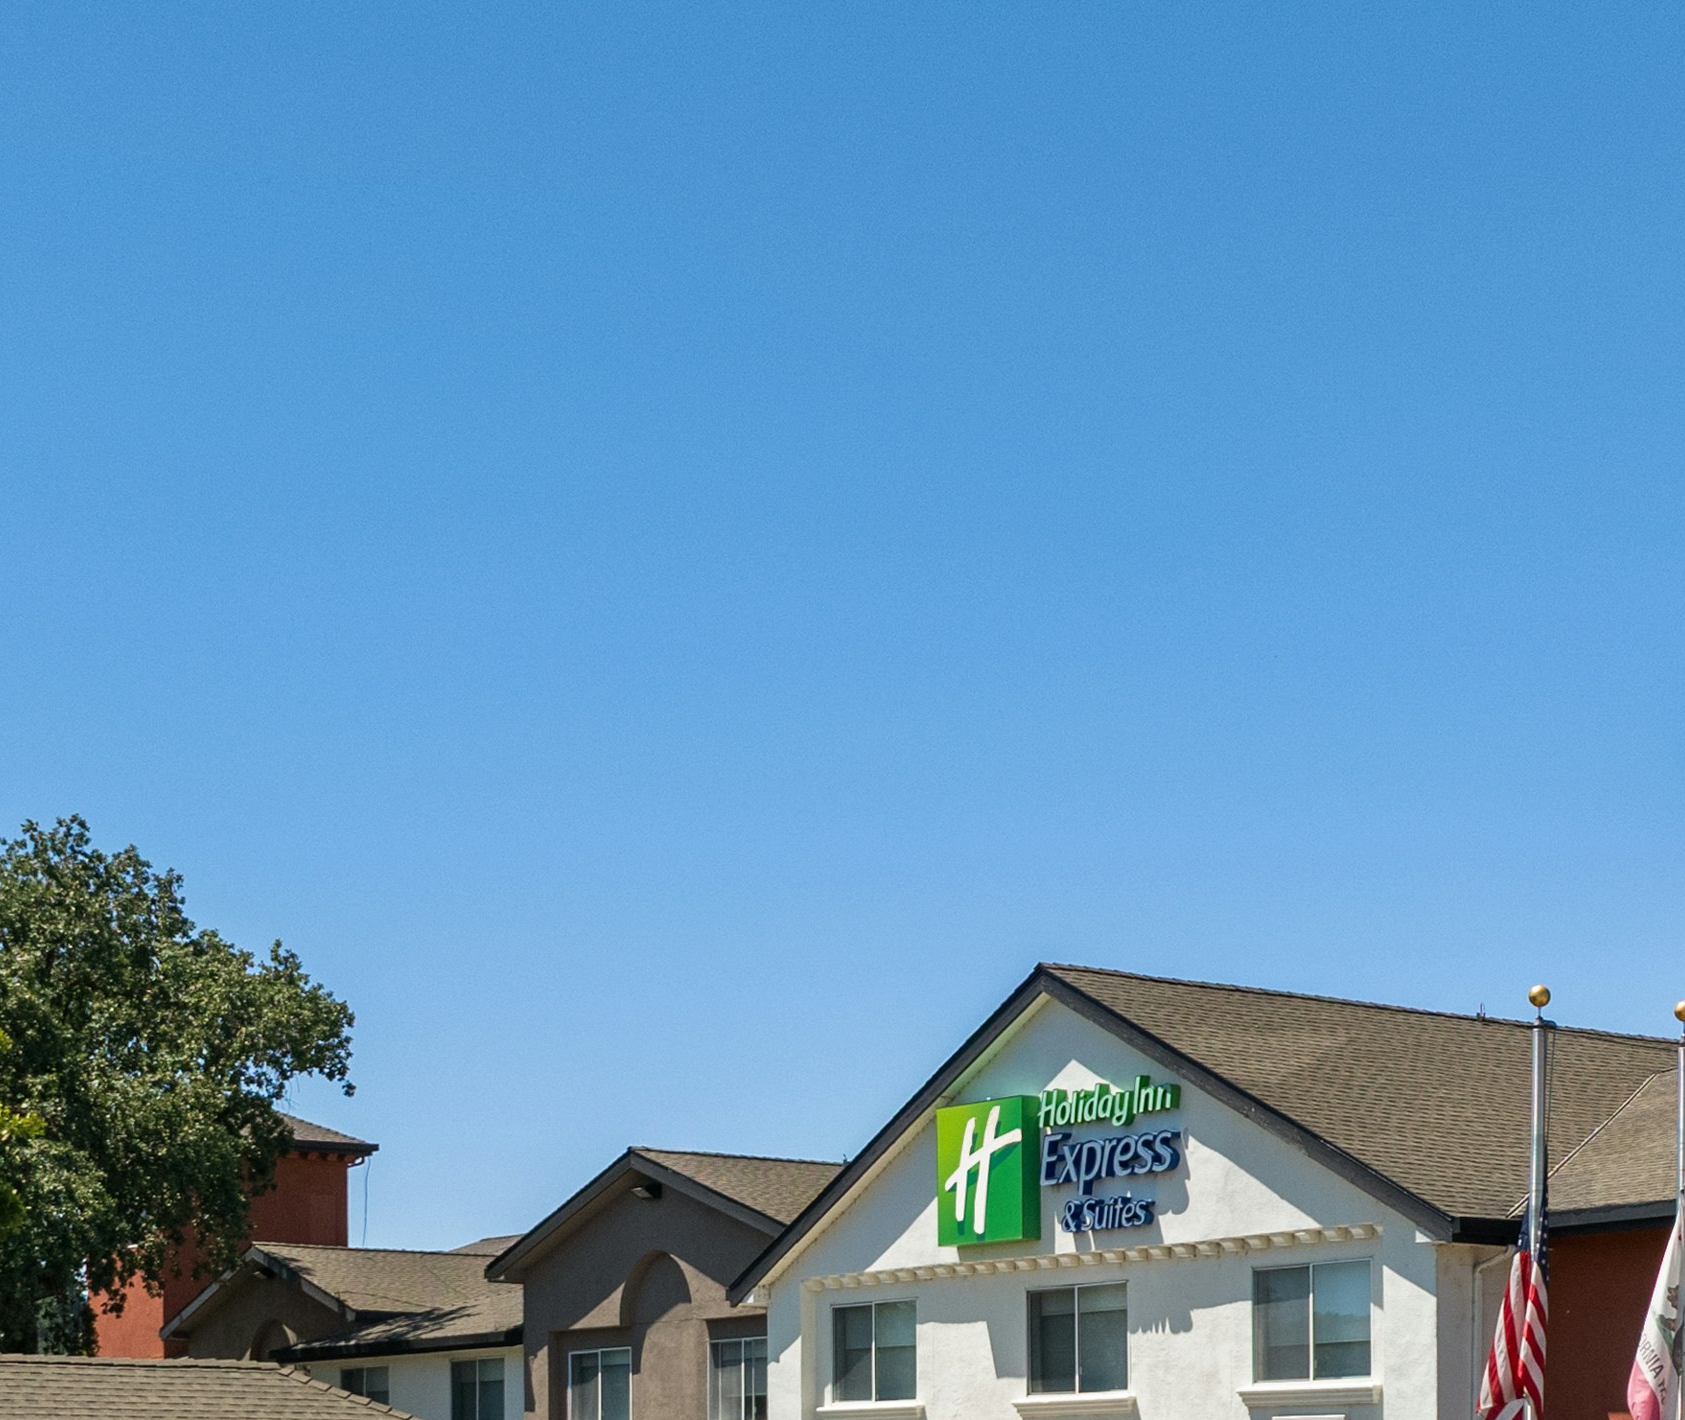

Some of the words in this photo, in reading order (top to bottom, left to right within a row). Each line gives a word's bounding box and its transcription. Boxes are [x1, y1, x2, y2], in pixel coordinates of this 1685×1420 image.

[1037, 1084, 1133, 1128] Holiday
[1132, 1076, 1176, 1114] Inn
[1040, 1130, 1177, 1195] Express
[1061, 1200, 1079, 1232] &
[1080, 1197, 1153, 1231] Suites
